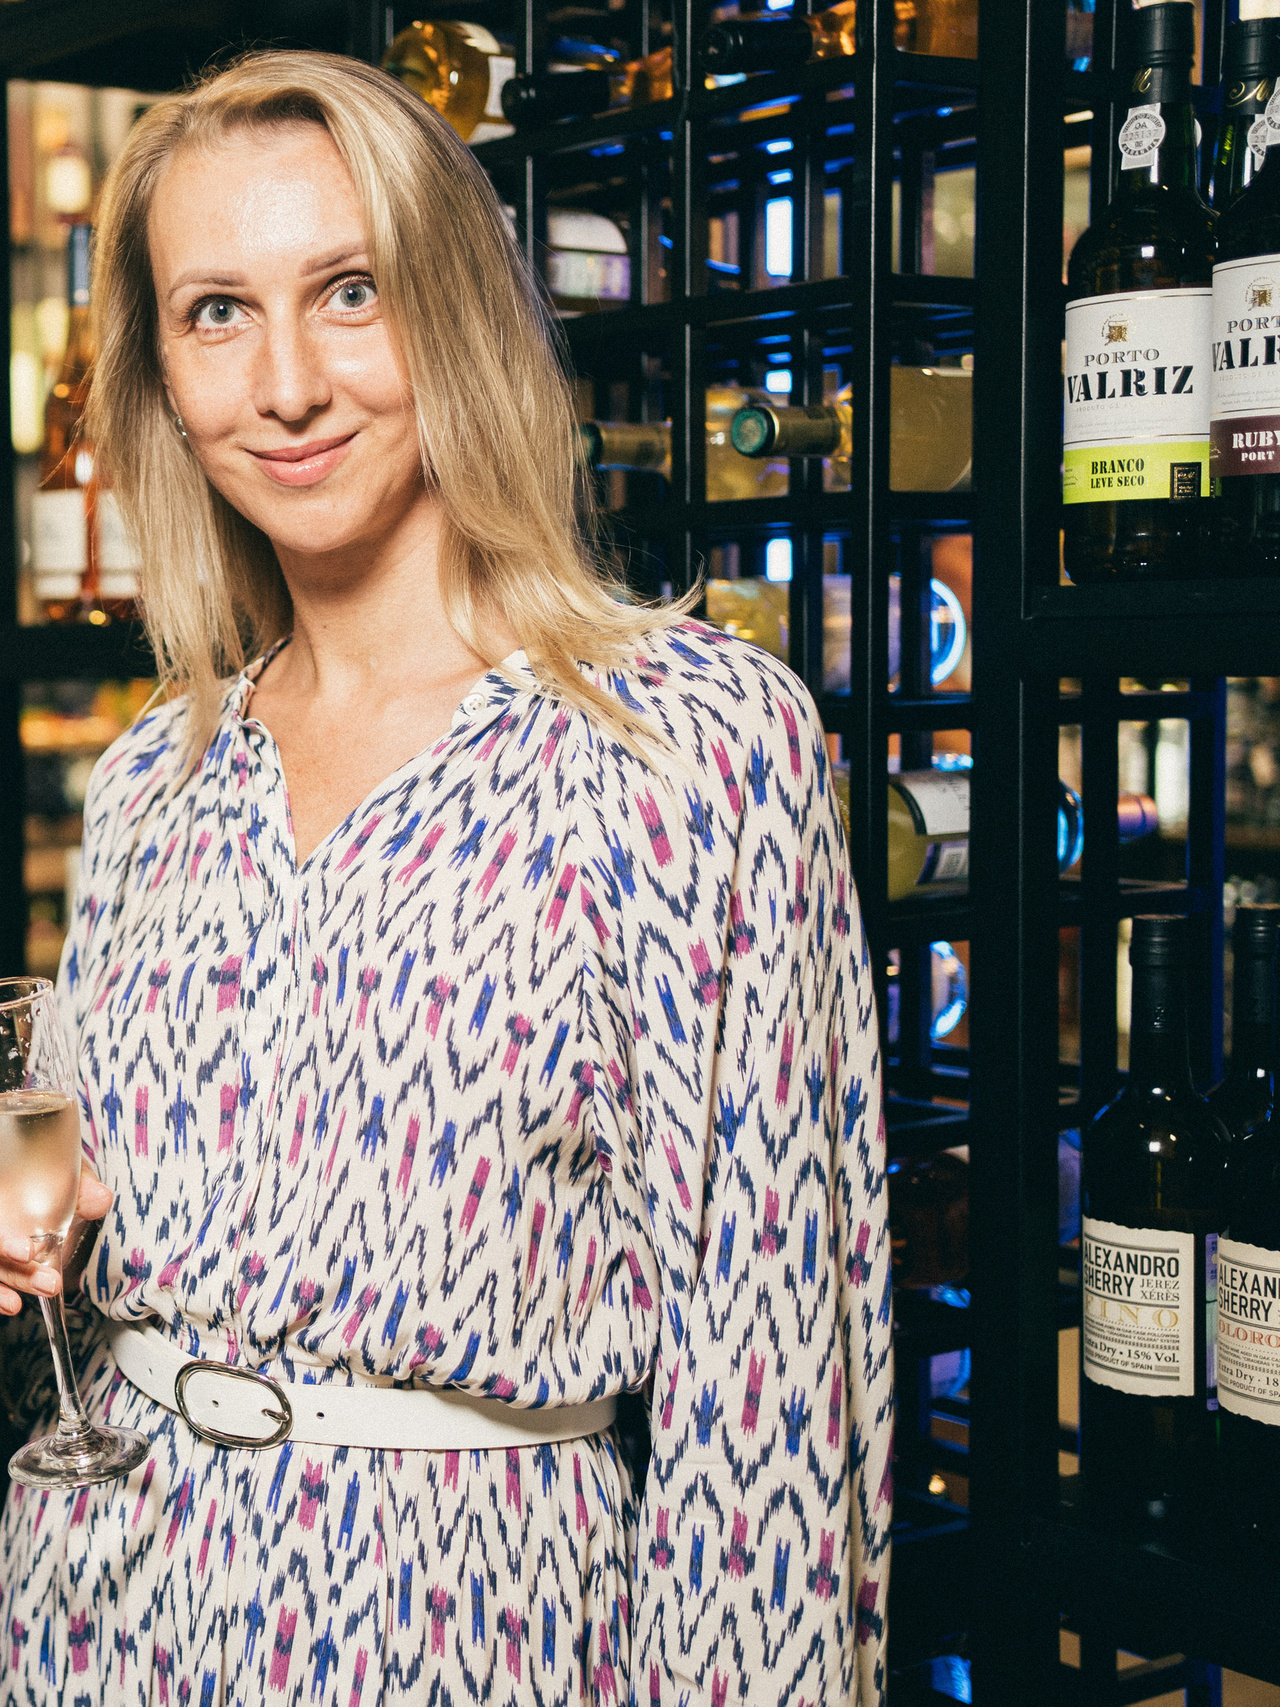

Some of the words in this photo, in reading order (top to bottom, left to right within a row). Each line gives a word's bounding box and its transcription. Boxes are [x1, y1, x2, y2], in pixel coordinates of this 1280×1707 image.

[1084, 348, 1160, 367] PORTO
[1067, 365, 1194, 404] VALRIZ
[1241, 450, 1275, 462] PORT
[1091, 458, 1145, 475] BRANCO
[1090, 477, 1114, 489] LEVE
[1116, 475, 1145, 487] SECO
[1084, 1241, 1180, 1278] ALEXANDRO
[1084, 1263, 1135, 1298] SHERRY
[1140, 1278, 1180, 1290] JEREZ
[1218, 1263, 1280, 1299] ALEXAN
[1084, 1294, 1179, 1329] FINO
[1218, 1286, 1273, 1322] SHERRY
[1094, 1352, 1120, 1365] PRODUCT
[1131, 1361, 1153, 1371] SPAIN
[1100, 1341, 1117, 1356] Dry
[1127, 1349, 1151, 1360] 15%
[1154, 1352, 1180, 1363] Vol.
[1236, 1368, 1254, 1385] Dry
[1229, 1379, 1256, 1393] PRODUCT
[1257, 1387, 1268, 1395] OF
